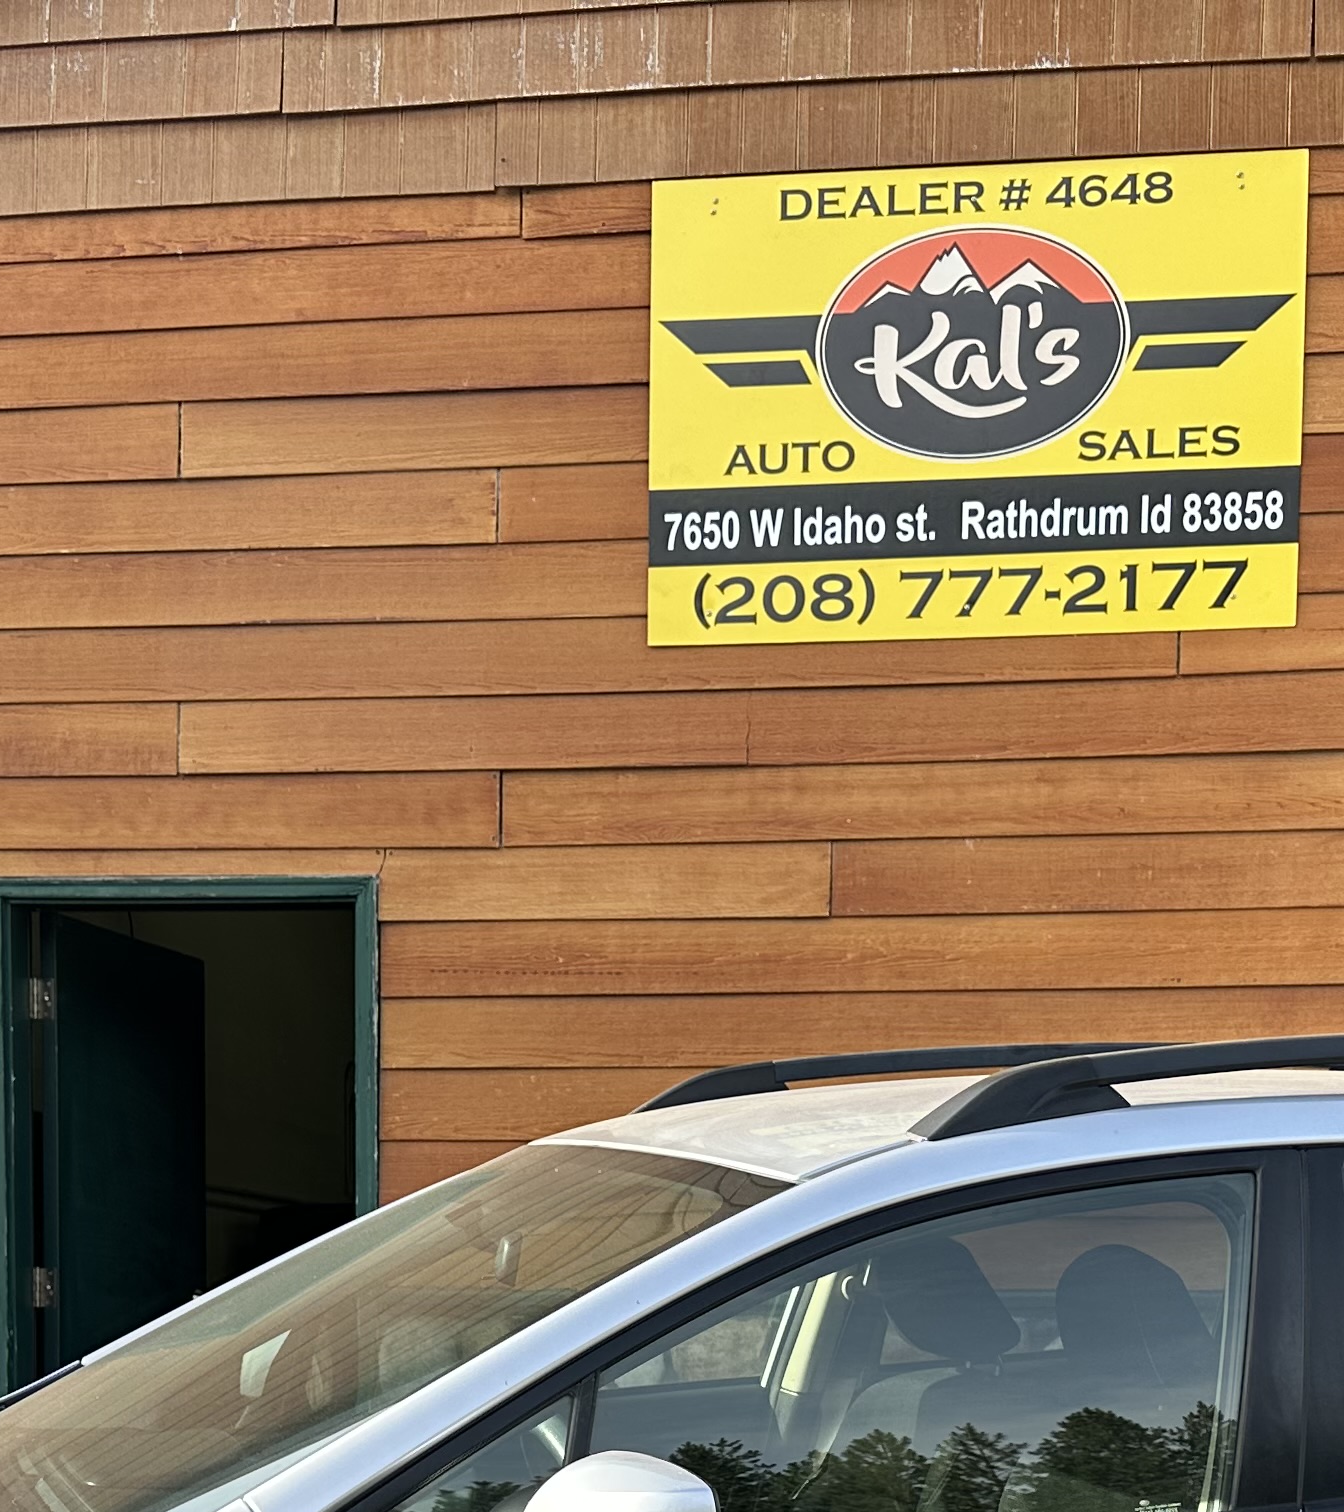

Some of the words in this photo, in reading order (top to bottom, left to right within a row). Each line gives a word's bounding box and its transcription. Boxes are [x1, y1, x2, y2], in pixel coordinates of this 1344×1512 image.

[780, 181, 984, 221] DEALER
[1000, 178, 1032, 211] #
[1045, 171, 1174, 208] 4648
[854, 301, 1080, 418] Kal's
[724, 441, 855, 475] AUTO
[1078, 425, 1240, 461] SALES
[664, 511, 740, 551] 7650
[750, 507, 784, 548] W
[794, 505, 885, 546] Idaho
[895, 504, 936, 543] st.
[961, 497, 1129, 540] Rathdrum
[1140, 494, 1172, 534] Id
[1182, 490, 1284, 533] 83858
[694, 568, 875, 630] (208)
[899, 558, 1249, 620] 777-2177
